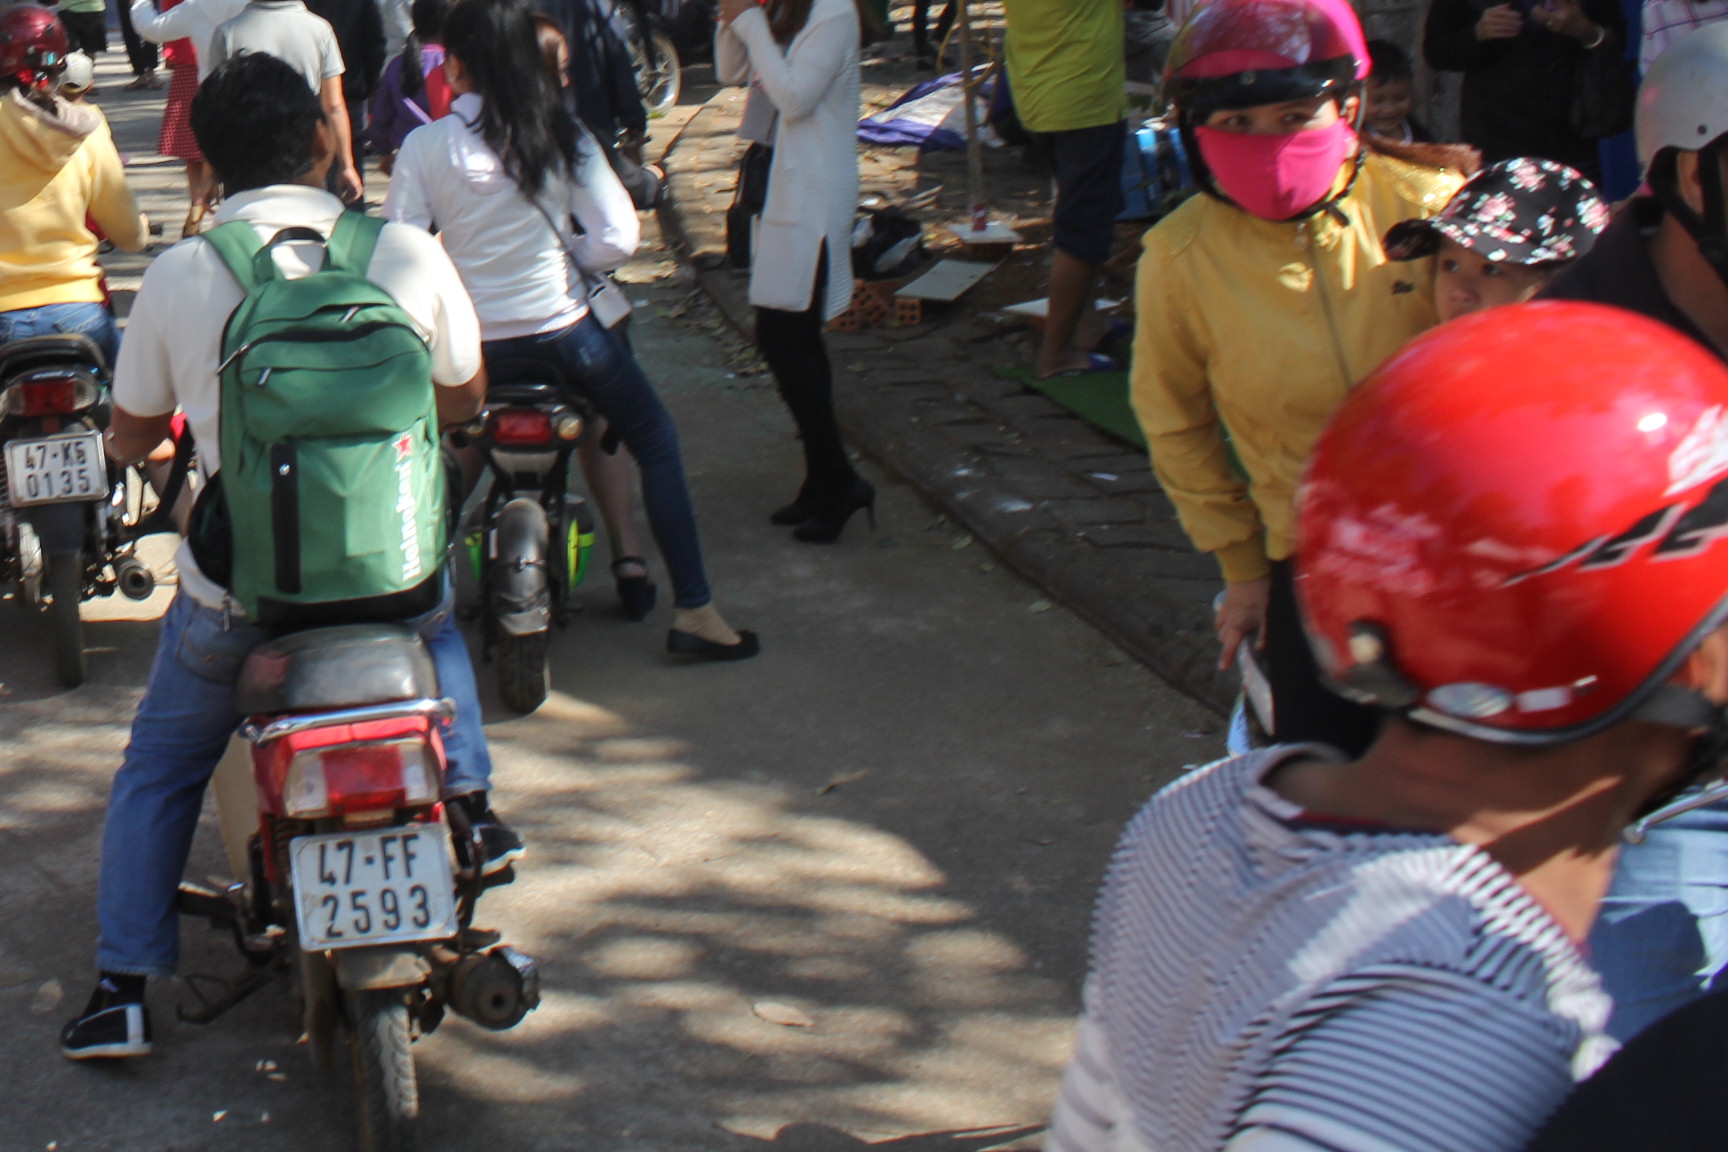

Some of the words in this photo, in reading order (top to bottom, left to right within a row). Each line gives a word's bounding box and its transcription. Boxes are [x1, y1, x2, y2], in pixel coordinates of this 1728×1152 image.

[27, 468, 90, 498] 0135
[395, 460, 421, 582] Heineken
[319, 833, 420, 886] 47-FF
[322, 884, 431, 939] 2593
